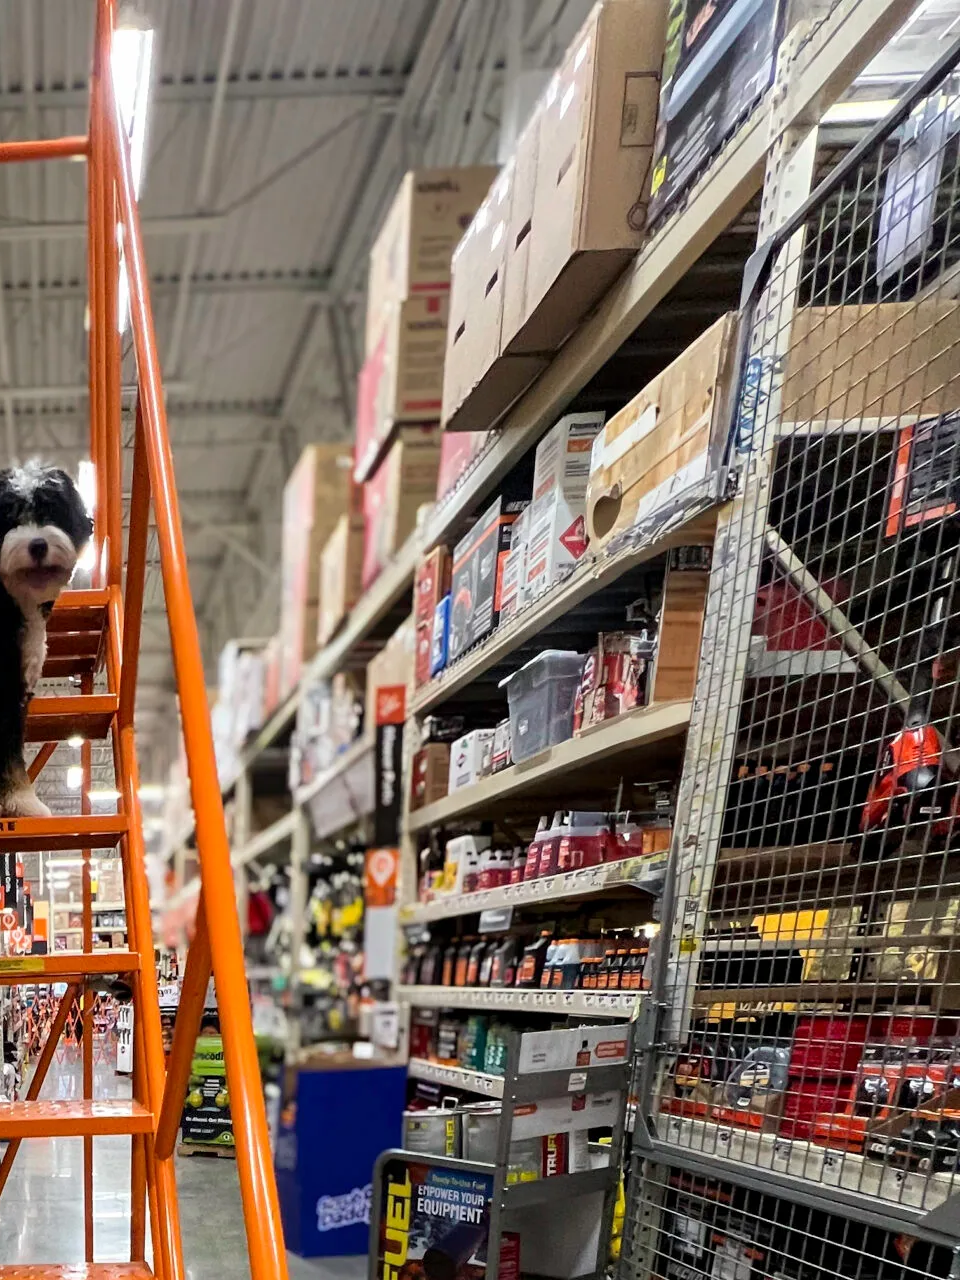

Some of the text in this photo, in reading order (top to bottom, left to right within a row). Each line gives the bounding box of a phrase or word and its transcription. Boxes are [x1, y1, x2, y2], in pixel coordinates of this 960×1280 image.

[417, 1184, 485, 1207] EMPOWER YOUR
[416, 1197, 484, 1225] EQUIPMENT
